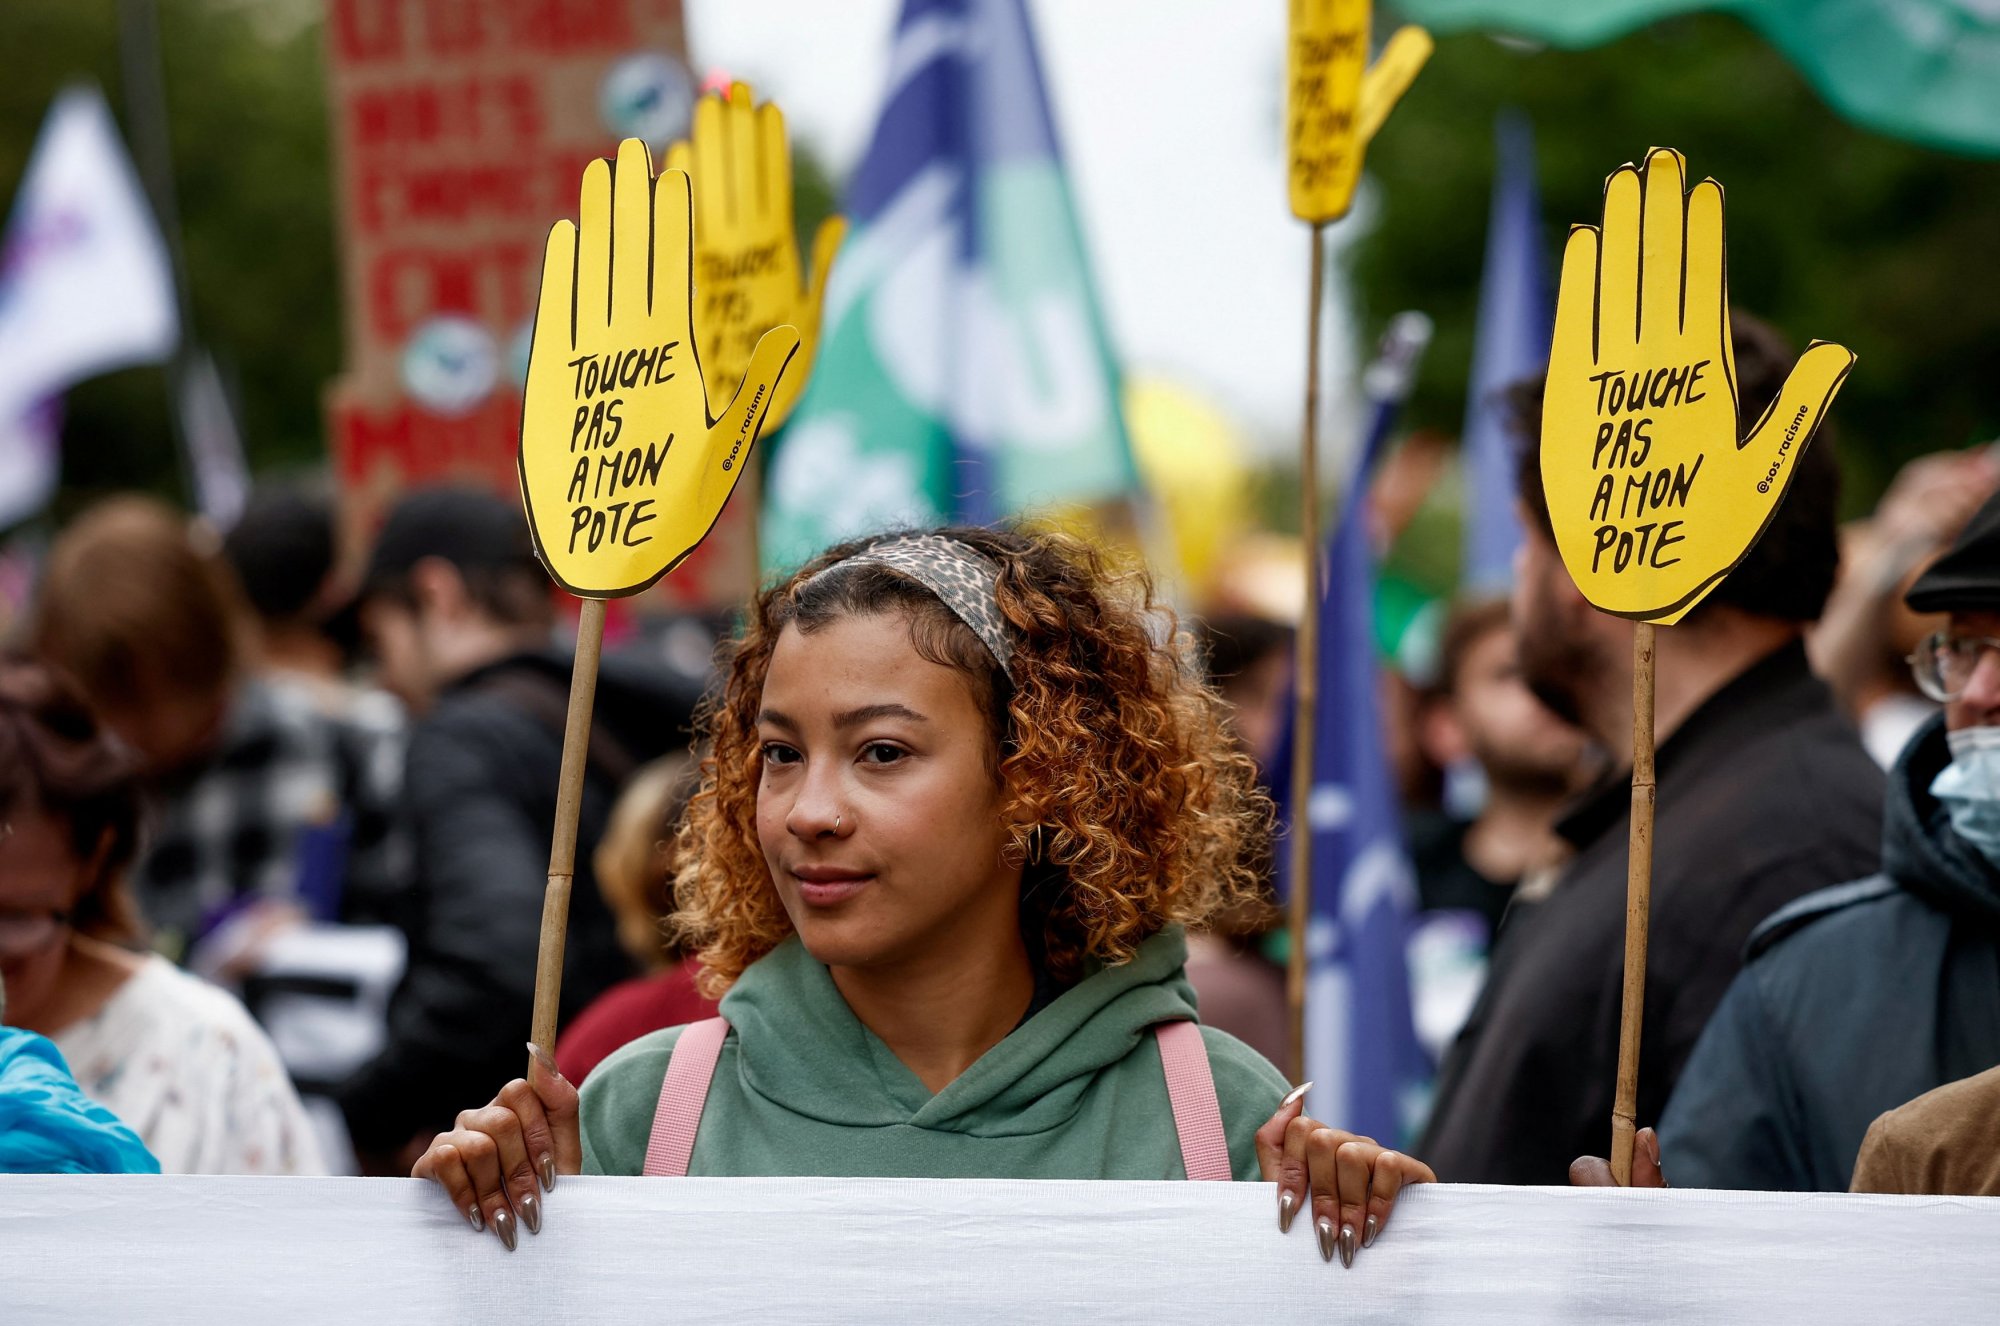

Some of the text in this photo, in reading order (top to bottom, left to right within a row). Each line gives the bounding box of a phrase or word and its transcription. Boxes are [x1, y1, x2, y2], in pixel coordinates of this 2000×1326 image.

[567, 341, 680, 400] TOUCHE
[1588, 359, 1711, 416] TOUCHE
[570, 399, 624, 453] PAS
[722, 383, 766, 471] @sos_racisme
[1592, 418, 1653, 470] PAS
[1756, 404, 1808, 494] @sos_racisme
[567, 432, 675, 503] A MON
[1589, 453, 1705, 522] A MON
[568, 499, 657, 554] POTE
[1591, 520, 1686, 574] POTE
